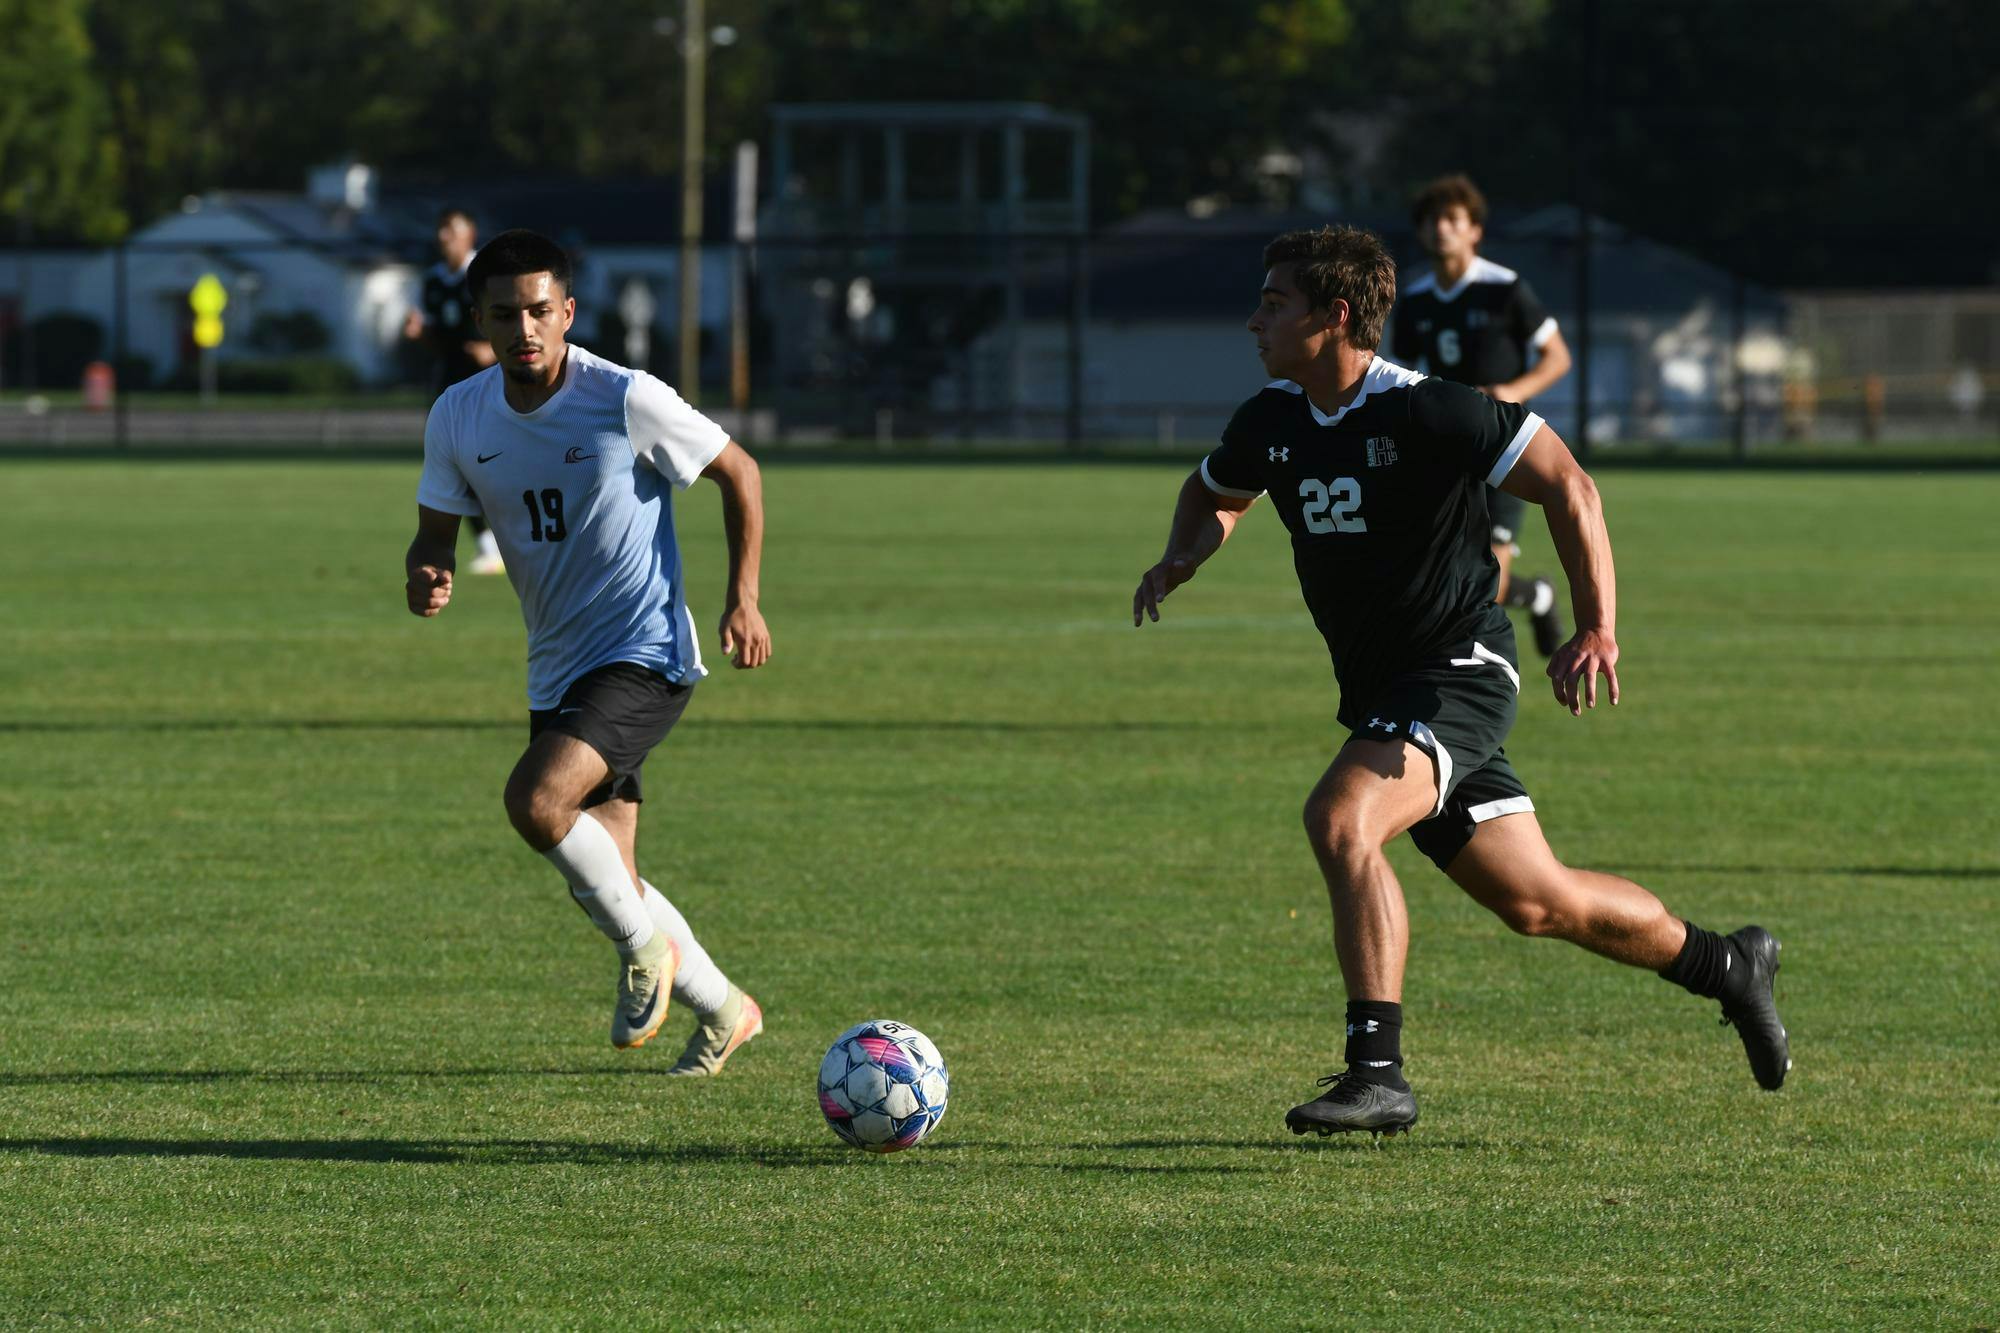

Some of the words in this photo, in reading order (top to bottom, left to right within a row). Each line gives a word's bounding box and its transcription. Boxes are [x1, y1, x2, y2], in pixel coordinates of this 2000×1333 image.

[1437, 328, 1461, 366] 6
[523, 488, 567, 542] 19
[1299, 477, 1368, 534] 22
